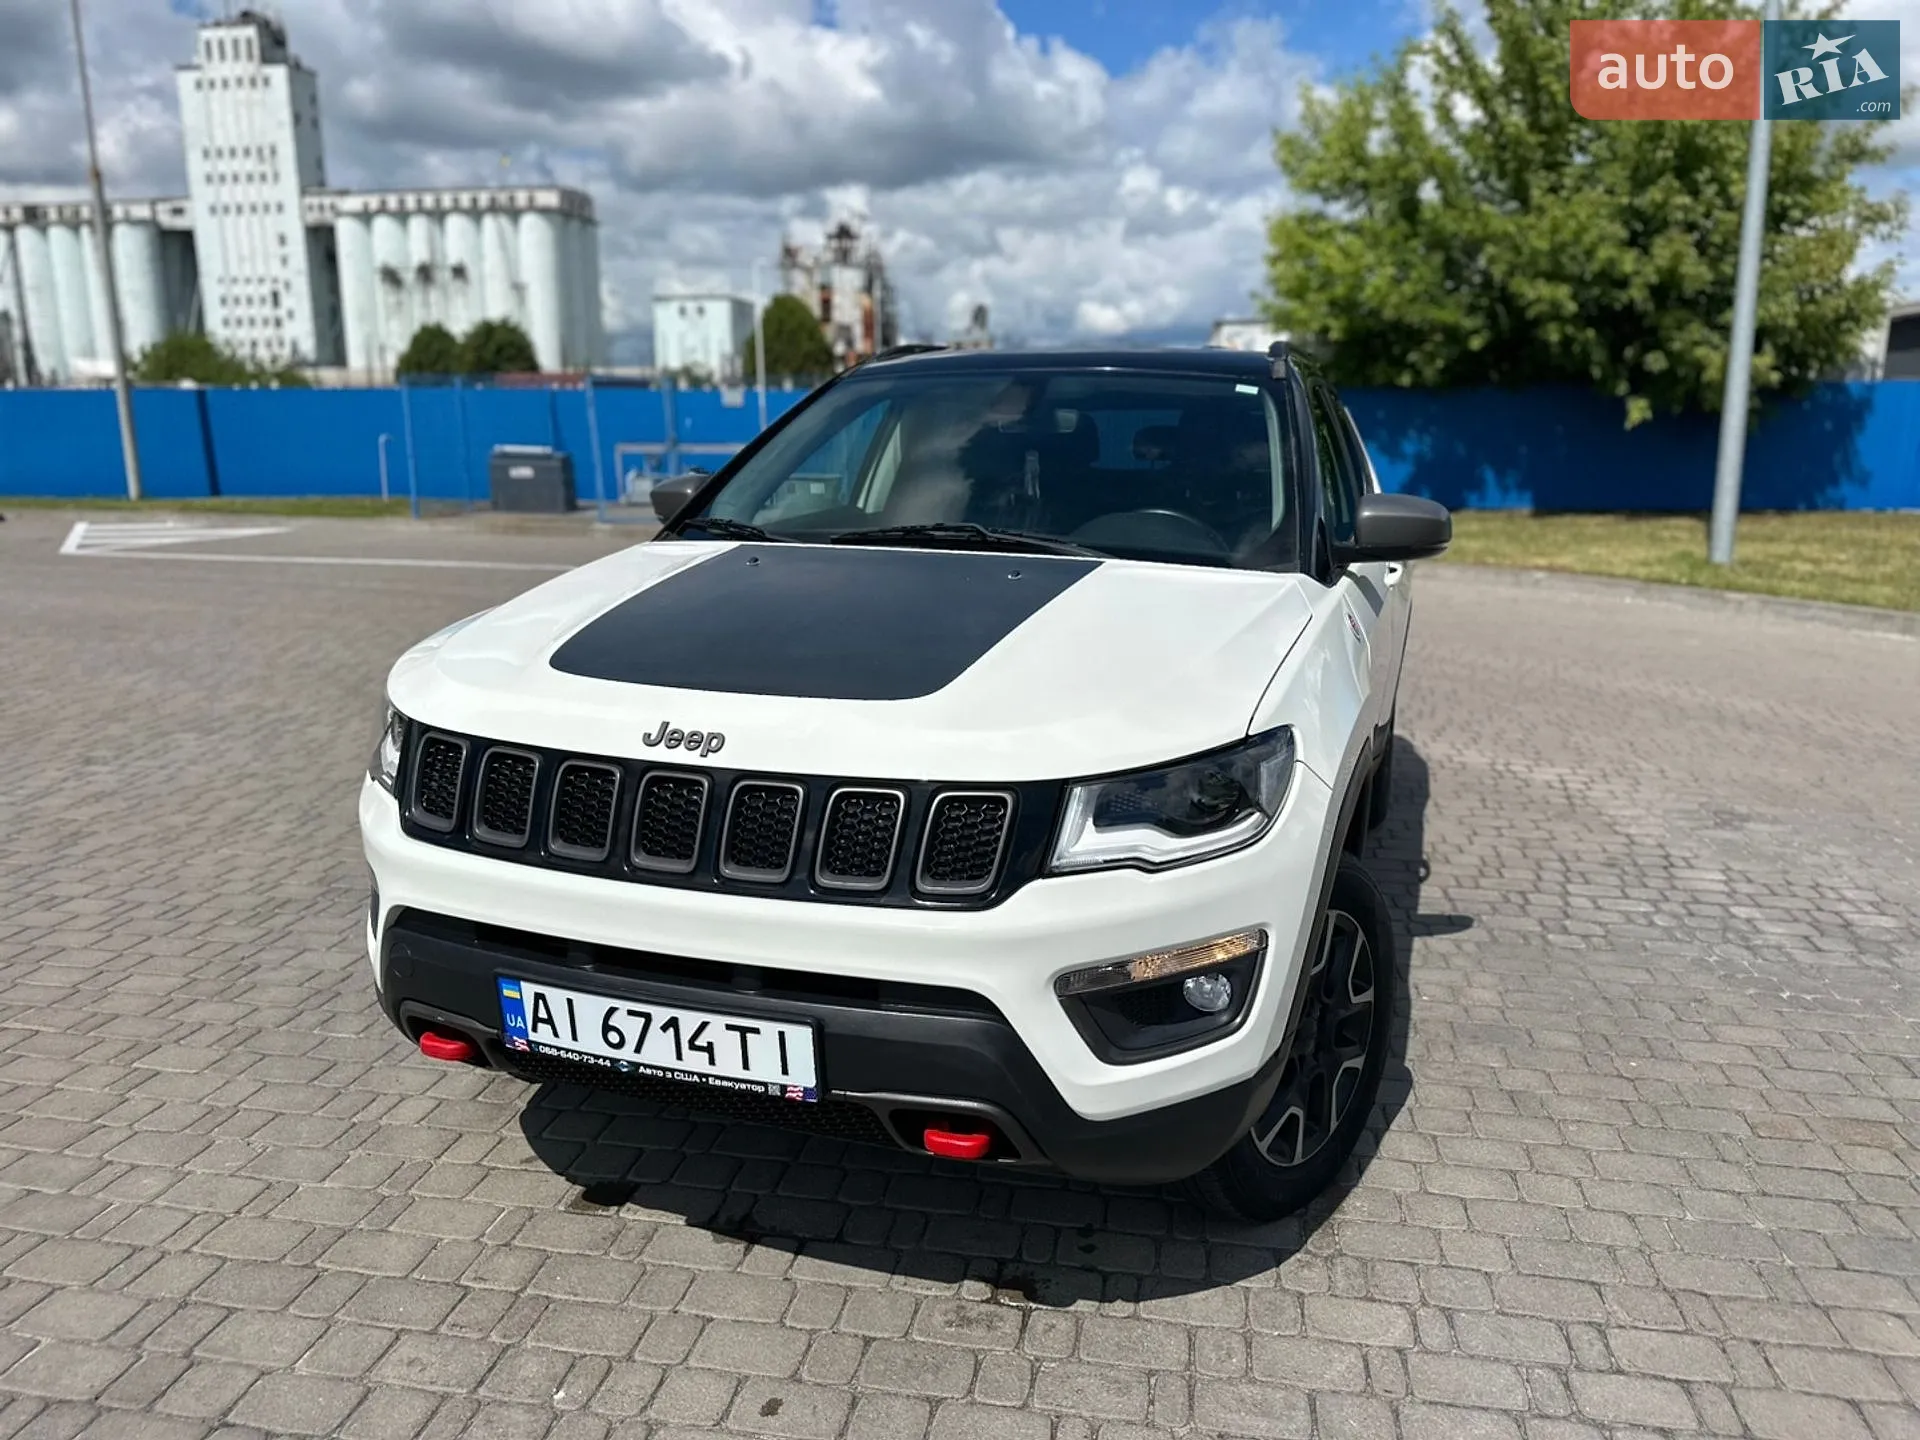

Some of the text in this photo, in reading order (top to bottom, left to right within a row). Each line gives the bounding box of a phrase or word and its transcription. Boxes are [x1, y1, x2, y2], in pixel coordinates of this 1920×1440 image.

[642, 721, 726, 758] Jeep
[506, 1013, 525, 1029] UA
[638, 1065, 664, 1077] Авто
[674, 1071, 700, 1083] США
[708, 1076, 766, 1093] Евакуатор
